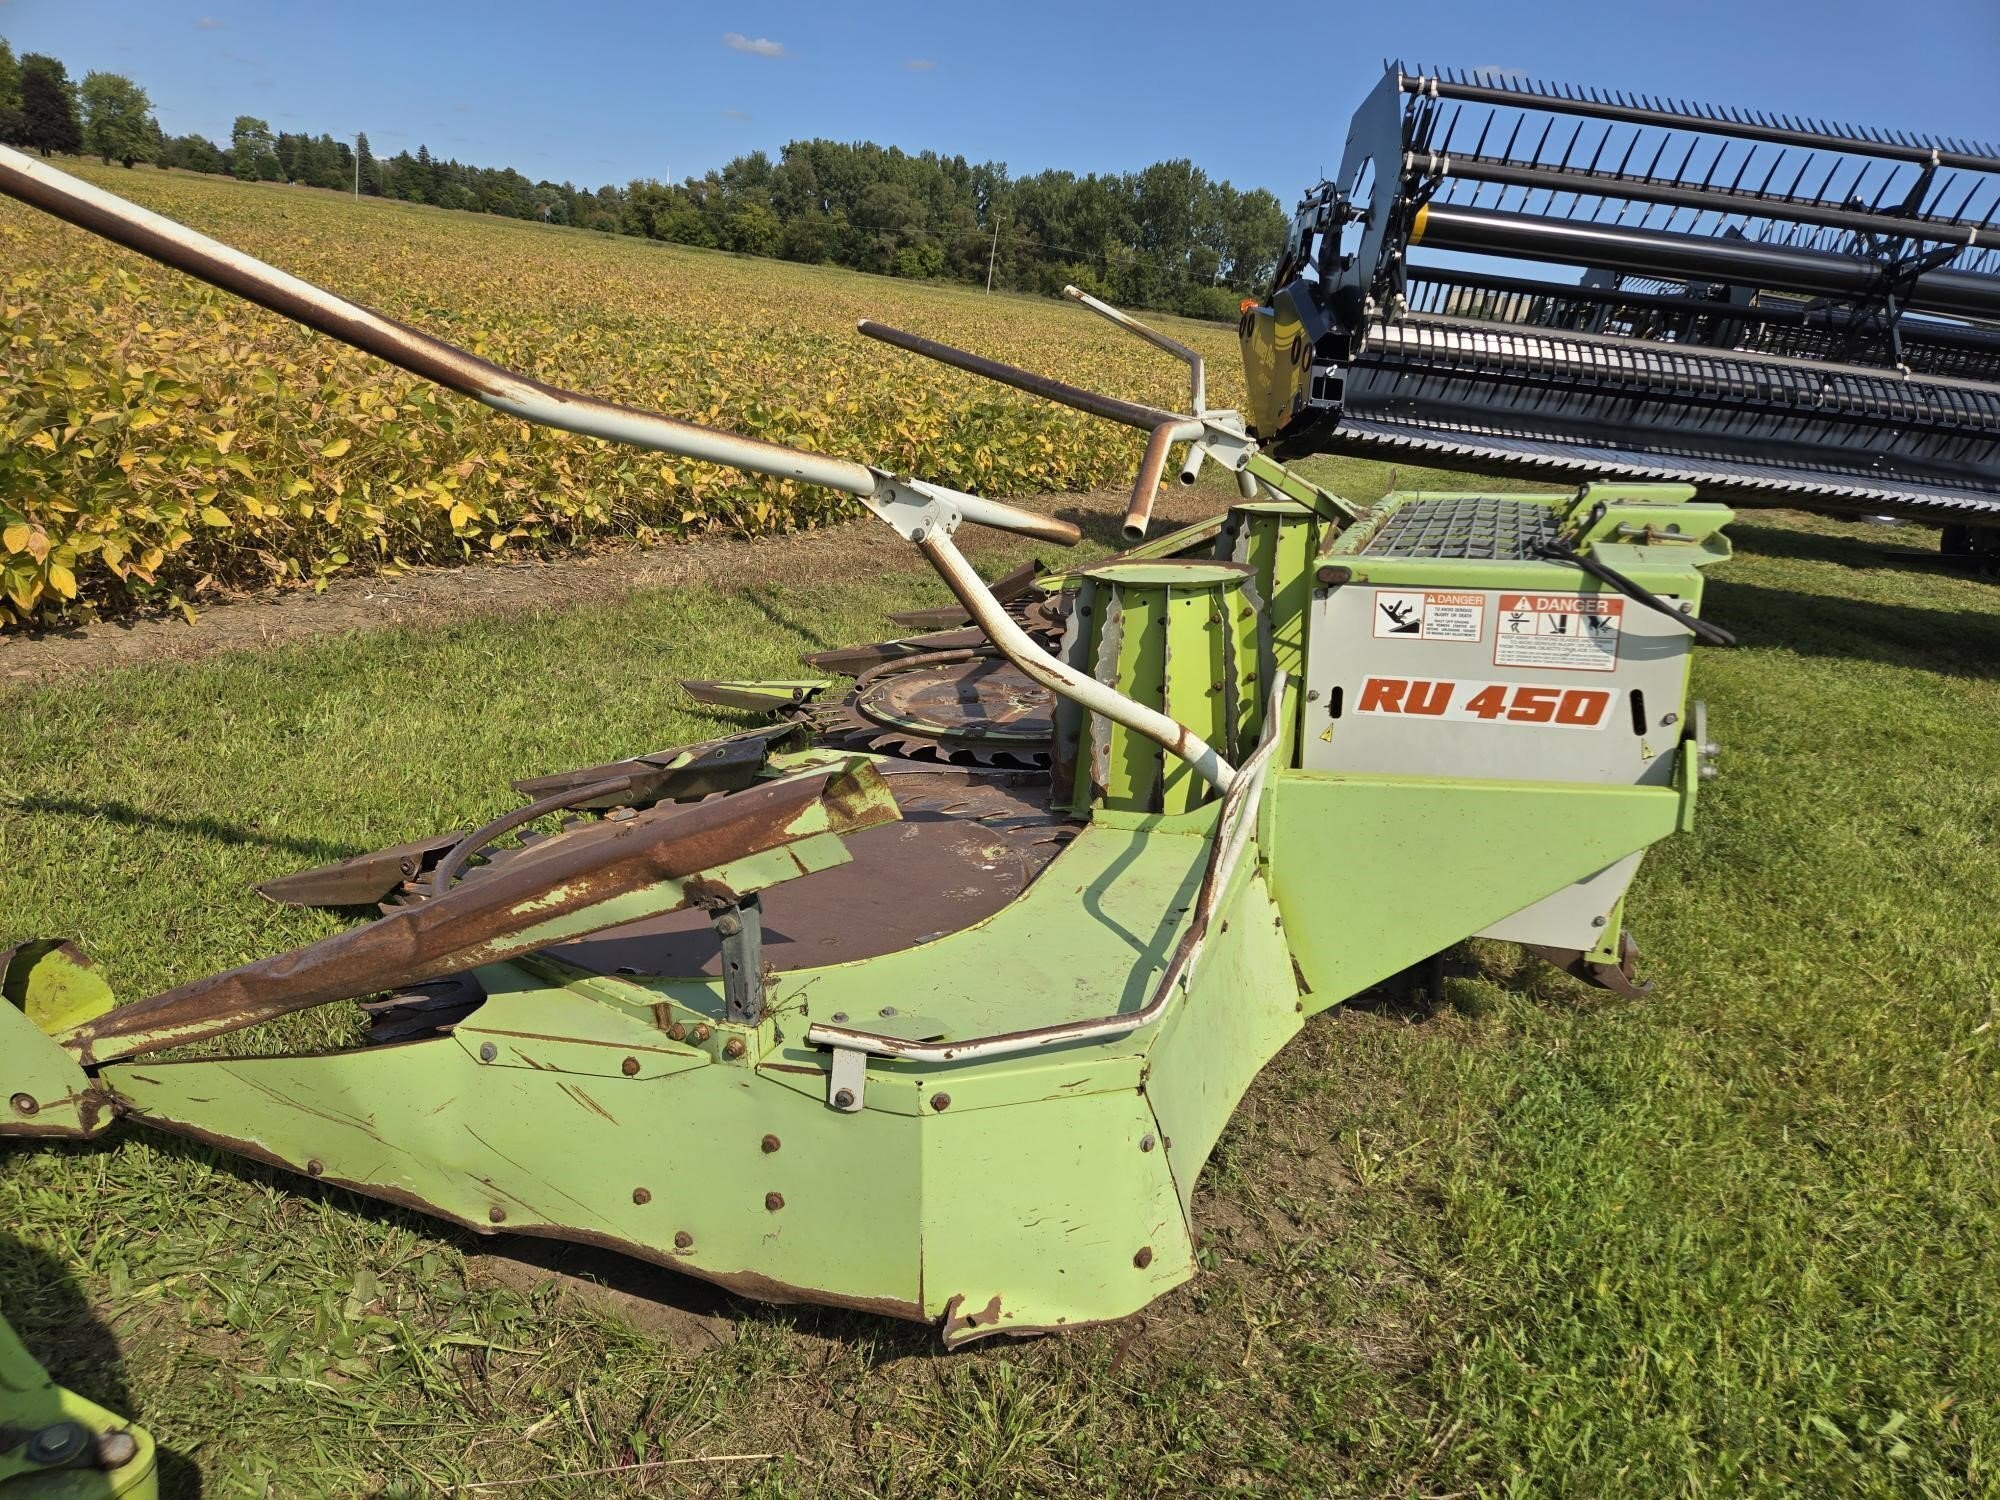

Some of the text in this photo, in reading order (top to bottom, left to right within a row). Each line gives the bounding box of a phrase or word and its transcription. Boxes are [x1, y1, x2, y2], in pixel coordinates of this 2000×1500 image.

[1437, 595, 1484, 606] DANGER
[1536, 598, 1609, 613] DANGER
[1358, 678, 1610, 726] RU 450
